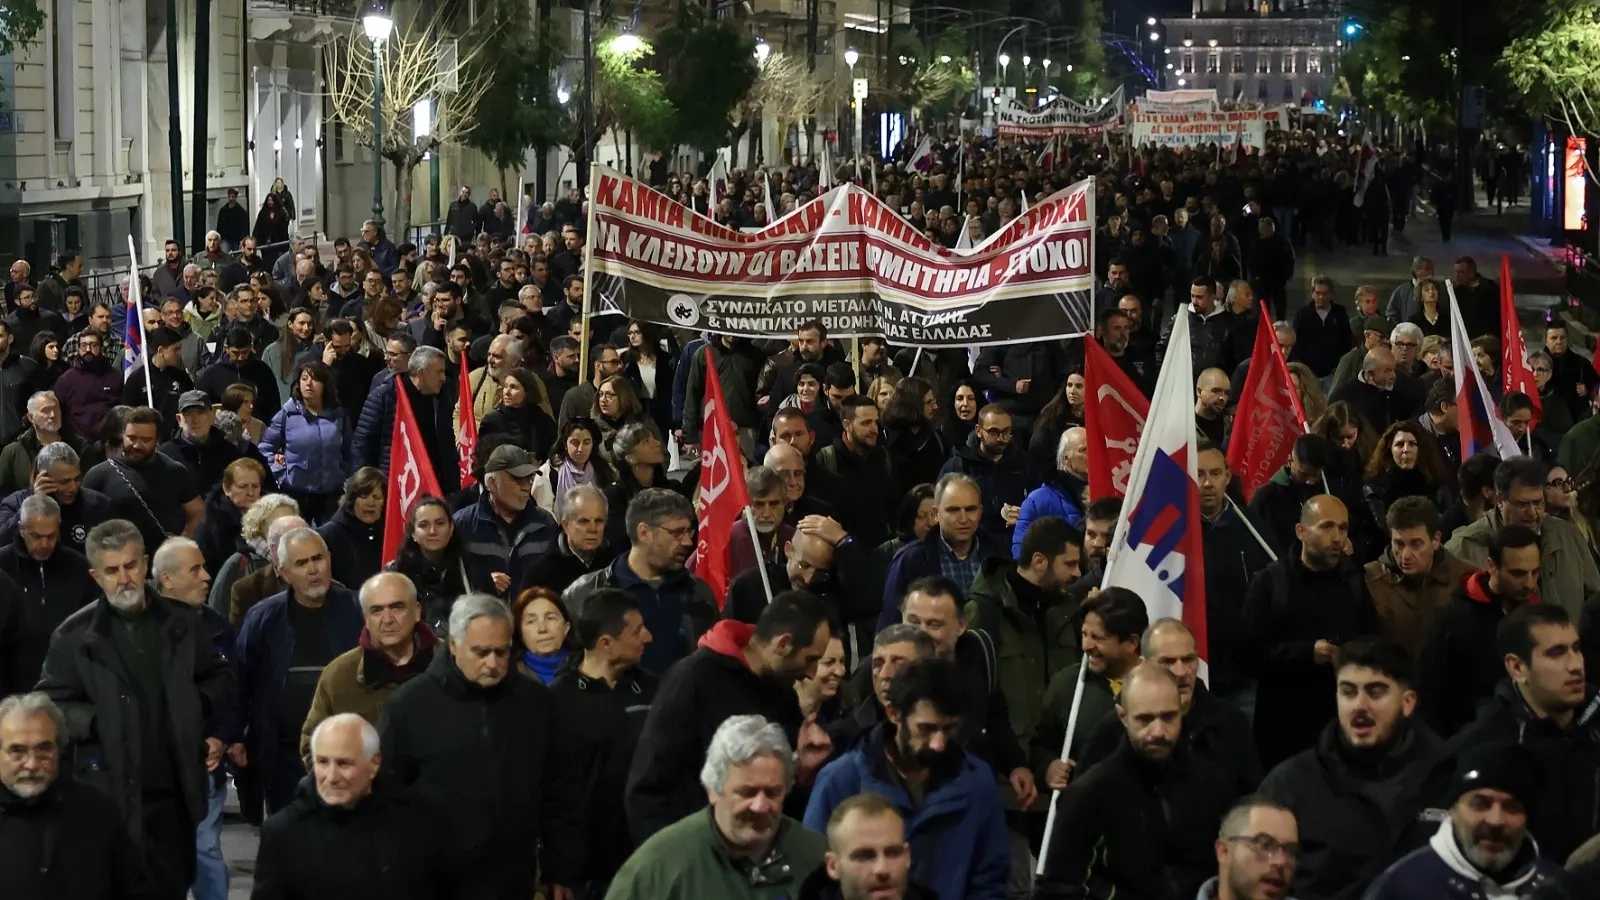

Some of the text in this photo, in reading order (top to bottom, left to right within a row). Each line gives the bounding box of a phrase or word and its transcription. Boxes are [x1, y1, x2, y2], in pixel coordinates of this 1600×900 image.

[596, 174, 684, 230] ΚΑΜΙΑ
[848, 193, 932, 253] ΚΑΜΙΑ
[594, 220, 621, 254] ΝΑ
[625, 231, 746, 276] ΚΛΕΙΣΟΥΝ
[747, 250, 774, 277] ΟΙ
[779, 241, 861, 275] ΒΑΣΕΙΣ
[865, 242, 991, 294] ΟΡΜΗΤΗΡΙΑ
[706, 300, 807, 315] ΣΥΝΔΙΚΑΤΟ
[708, 315, 721, 328] &
[725, 316, 816, 331] ΝΑΥΠ/ΚΗ
[911, 323, 993, 340] ΕΛΛΑΔΑΣ
